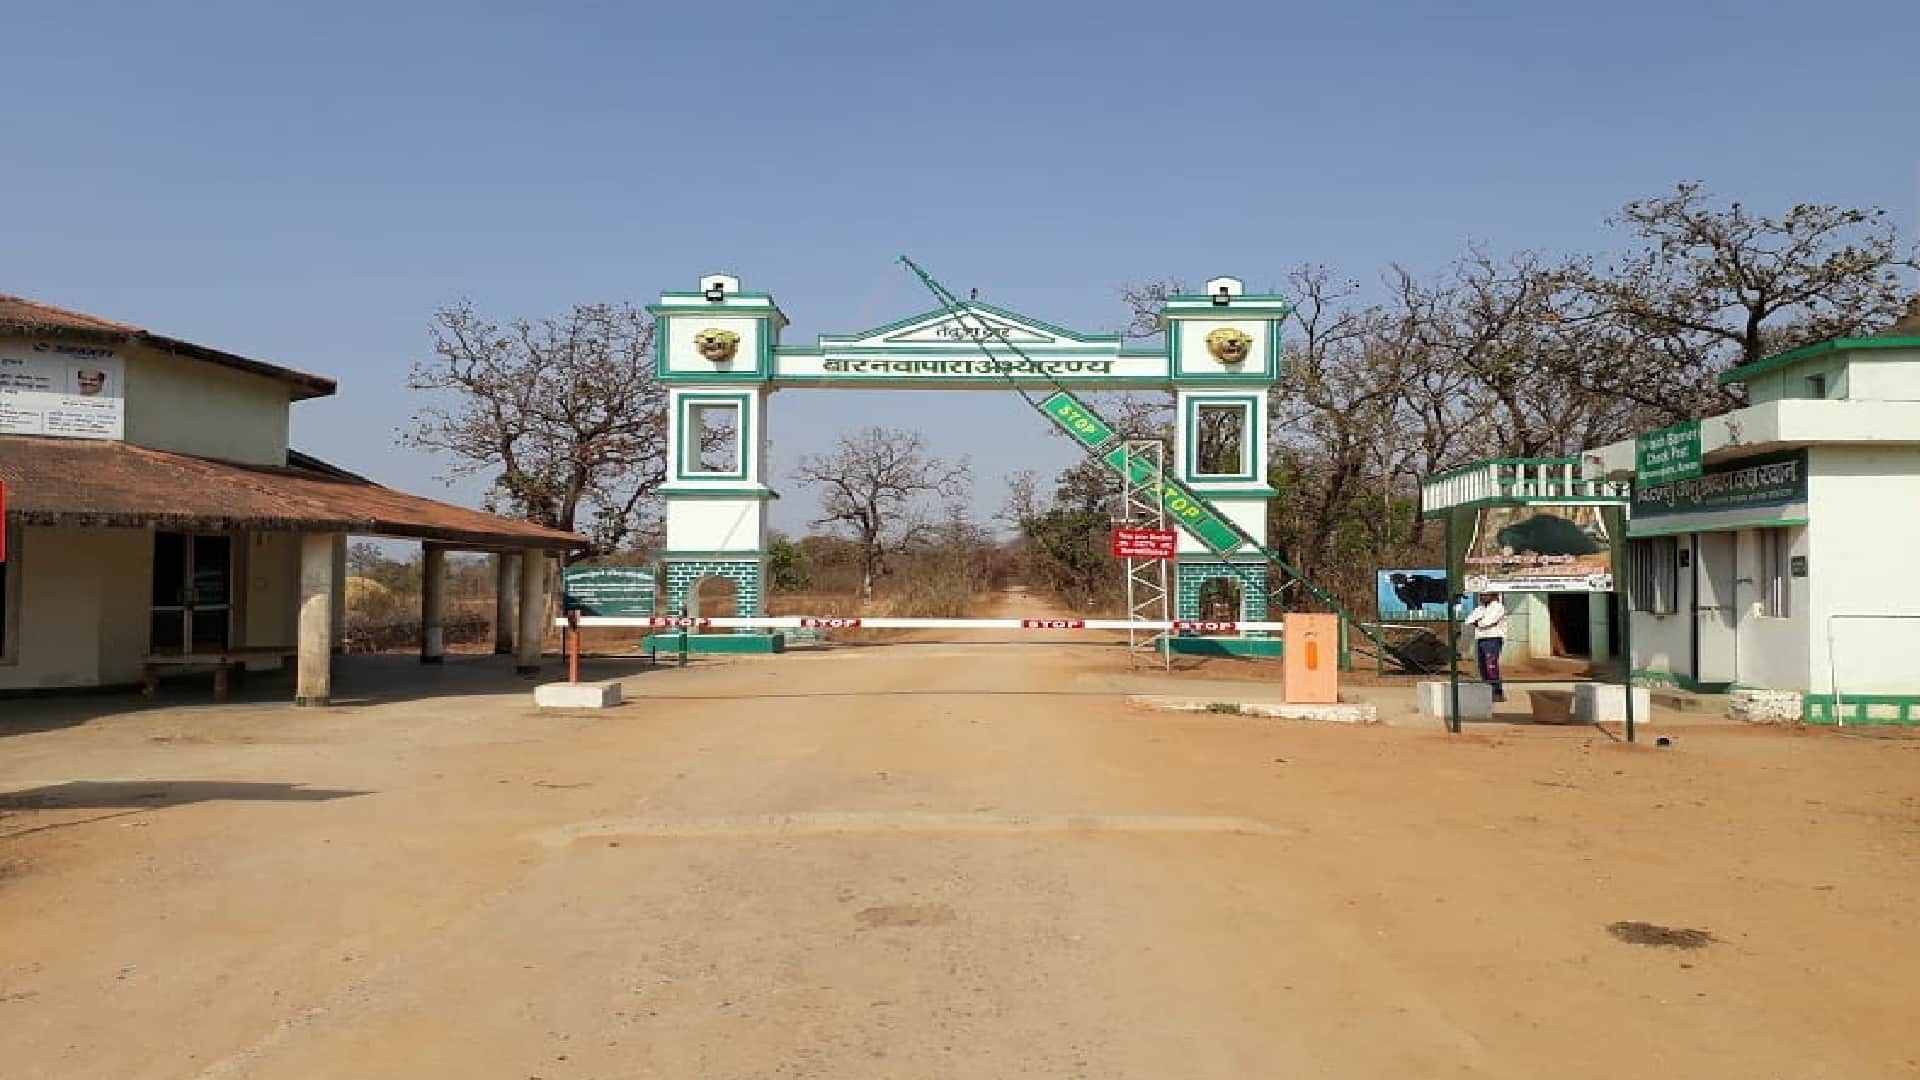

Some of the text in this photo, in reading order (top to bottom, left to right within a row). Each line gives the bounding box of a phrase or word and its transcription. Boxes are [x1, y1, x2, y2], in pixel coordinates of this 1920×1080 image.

[1058, 405, 1096, 434] STOP
[655, 617, 704, 627] STOP
[806, 617, 856, 628] STOP
[1028, 620, 1079, 629] STOP
[1181, 621, 1233, 631] STOP
